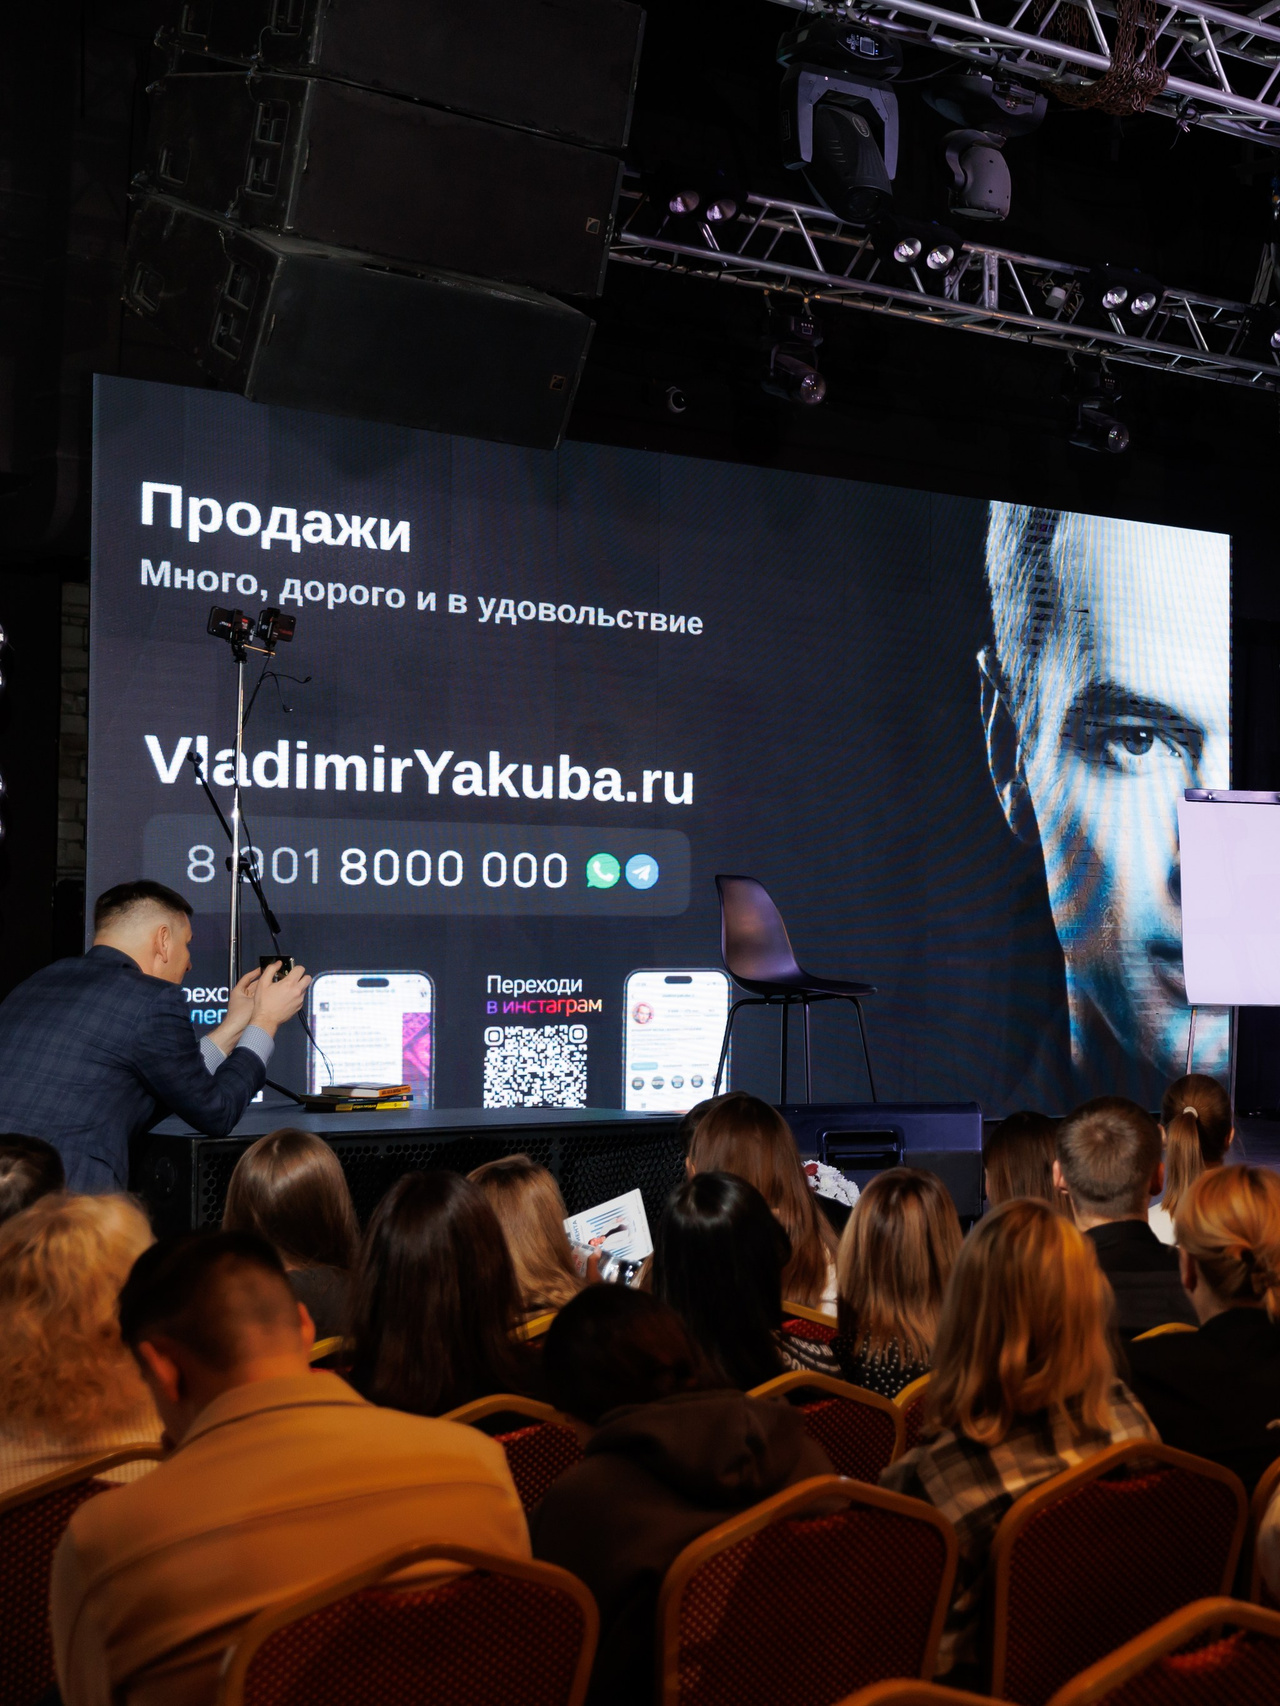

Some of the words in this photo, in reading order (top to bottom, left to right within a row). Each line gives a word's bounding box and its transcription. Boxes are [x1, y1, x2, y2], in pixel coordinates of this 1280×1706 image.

[141, 481, 411, 553] Продажи
[141, 558, 268, 602] Много,
[279, 577, 405, 609] дорого
[417, 590, 437, 612] и
[448, 593, 468, 614] в
[478, 596, 704, 635] удовольствие
[144, 734, 694, 805] VladimirYakuba.ru
[187, 844, 216, 883] 8
[340, 847, 464, 887] 8000
[481, 851, 568, 889] 000
[486, 1000, 499, 1015] в
[502, 998, 603, 1017] инстаграм
[487, 974, 584, 998] Переходи
